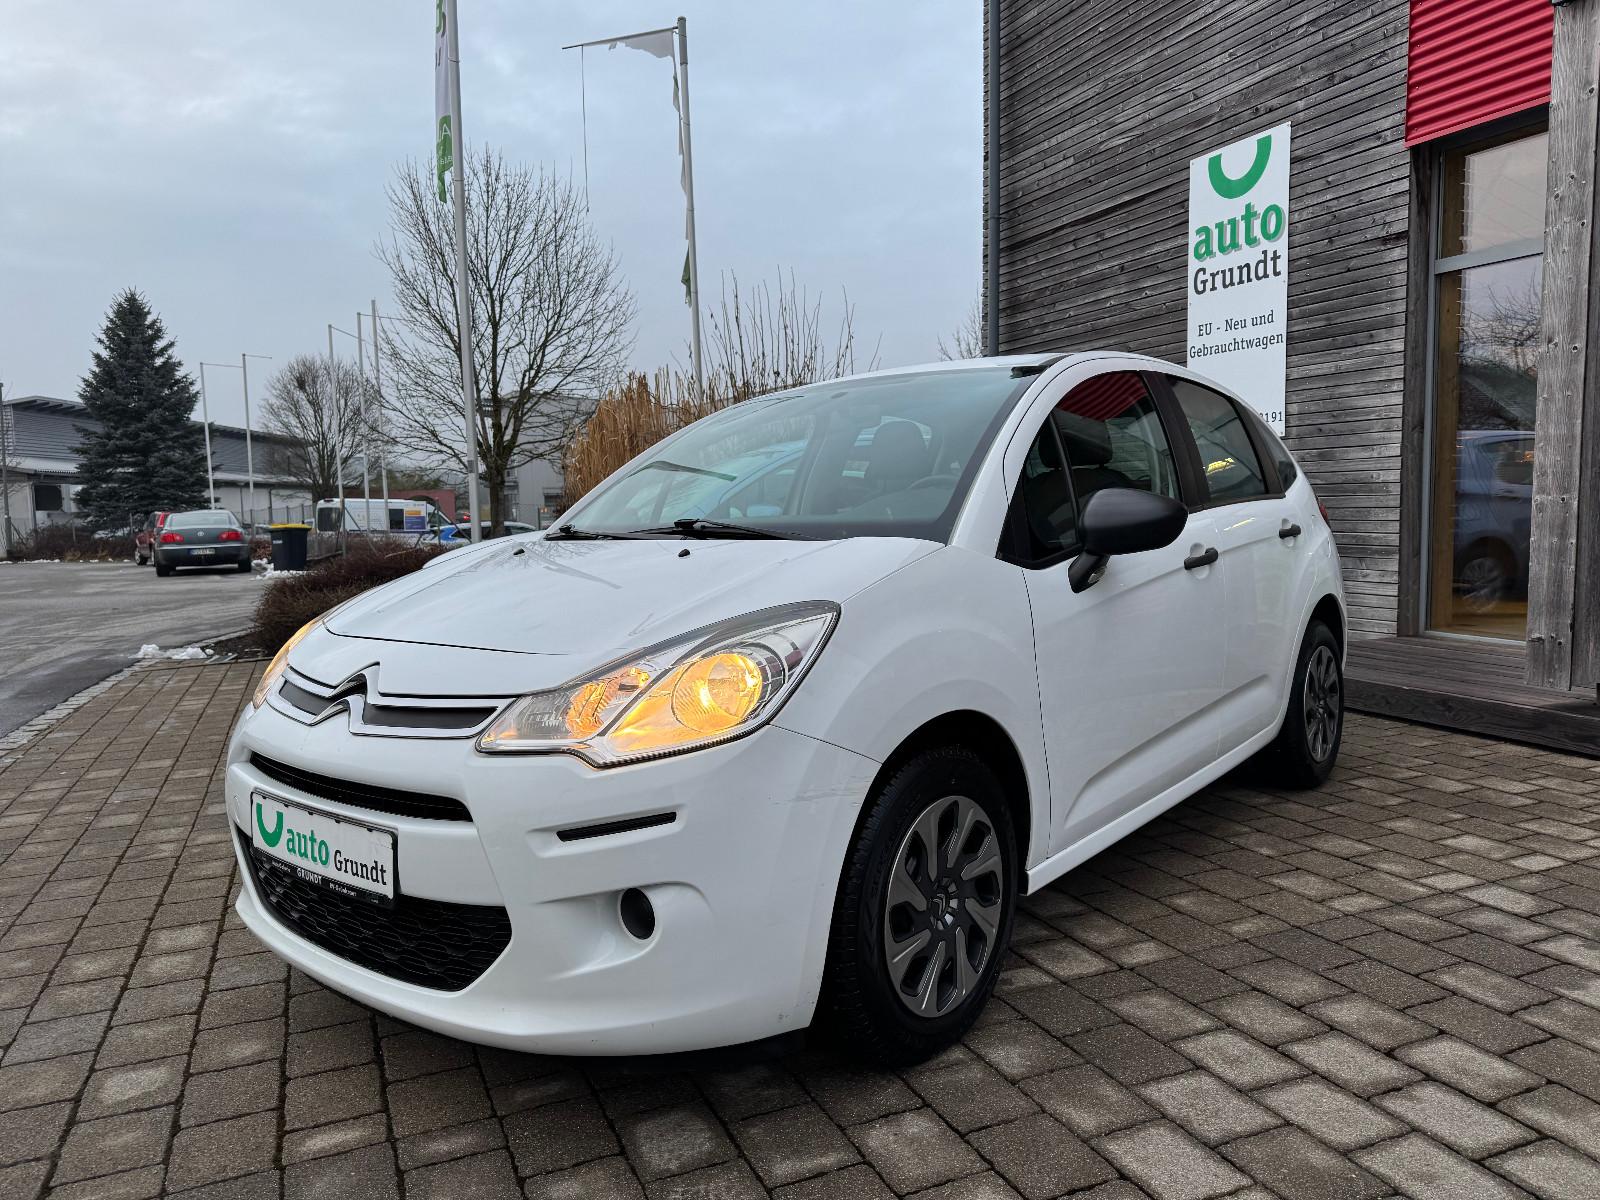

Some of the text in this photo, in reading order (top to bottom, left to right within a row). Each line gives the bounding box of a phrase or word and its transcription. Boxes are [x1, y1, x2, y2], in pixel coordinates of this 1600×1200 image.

[1193, 202, 1285, 262] auto
[1193, 250, 1282, 295] Grundt
[1198, 322, 1213, 337] EU
[1224, 317, 1247, 332] Neu
[1251, 309, 1275, 327] und
[1189, 333, 1284, 359] Gebrauchtwagen
[286, 828, 387, 886] auto Grundt
